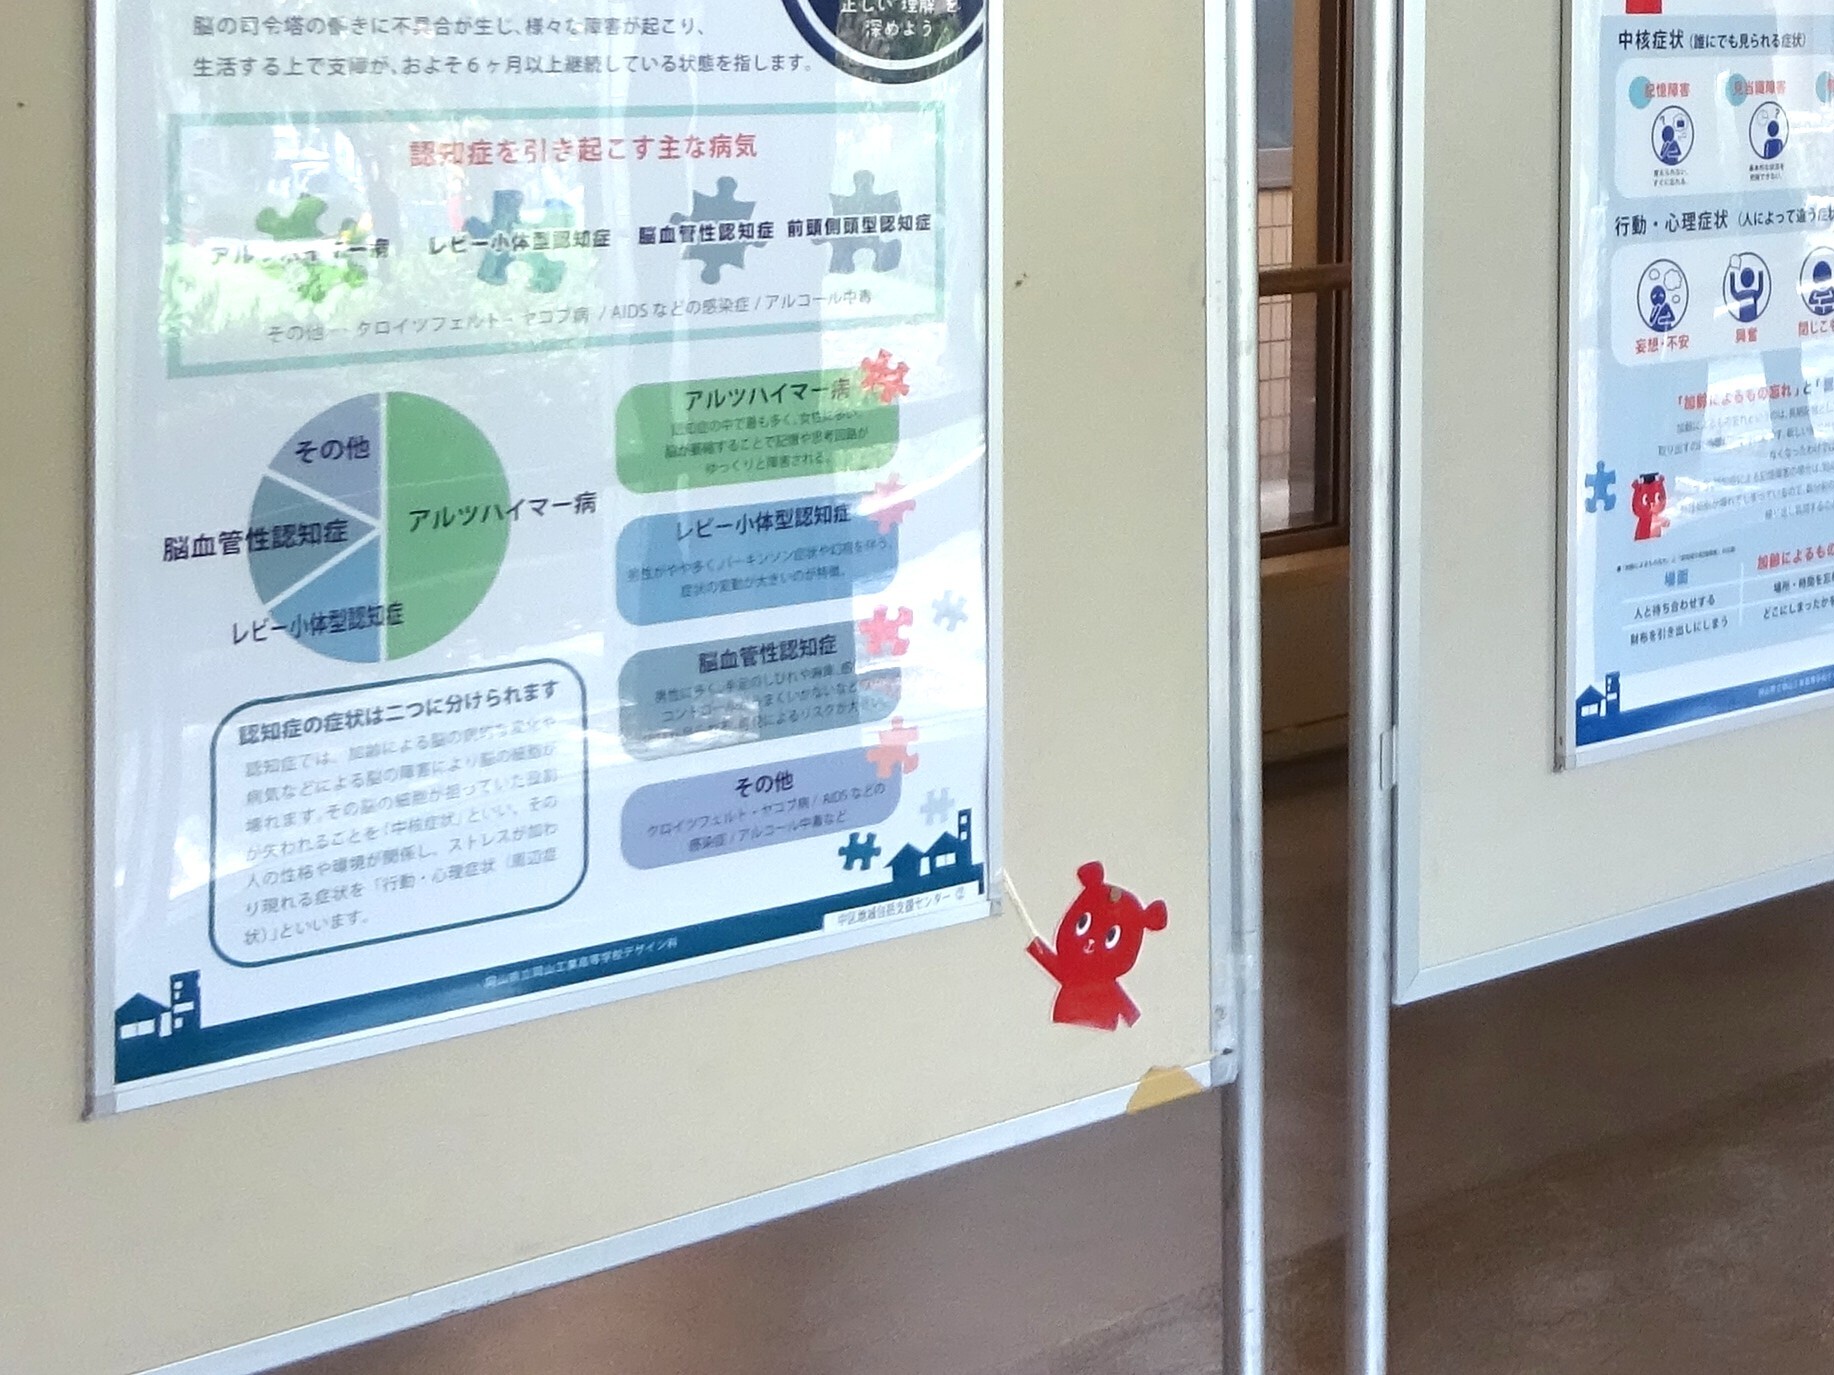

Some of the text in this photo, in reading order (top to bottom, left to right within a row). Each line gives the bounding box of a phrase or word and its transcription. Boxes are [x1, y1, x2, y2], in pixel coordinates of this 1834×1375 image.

[865, 18, 934, 39] 深めよう
[1618, 28, 1684, 52] 中核症状
[1643, 81, 1691, 98] 記憶障害
[409, 133, 757, 167] 認知症を引き起こす主な病気
[429, 213, 931, 255] レビー小体型認知症 脳血管性認知症 前頭側頭型認知症
[1615, 211, 1729, 237] 行動・心理症状
[1635, 334, 1690, 354] 妄想・不安
[1734, 327, 1758, 343] 興奮
[685, 378, 851, 412] アルツハイマー病
[295, 436, 370, 463] その他
[408, 491, 597, 532] アルツハイマー病
[676, 504, 851, 541] レビー小体型認知症
[163, 519, 348, 563] 脳血管性認知症
[1633, 592, 1716, 620] 人と待ち合わせする
[232, 602, 404, 645] レビー小体型認知症
[1630, 616, 1729, 647] 財布を引き出しにしまう
[699, 634, 838, 673] 脳血管性認知症
[239, 678, 560, 746] 認知症の症状は二つに分けられます
[736, 770, 795, 797] その他
